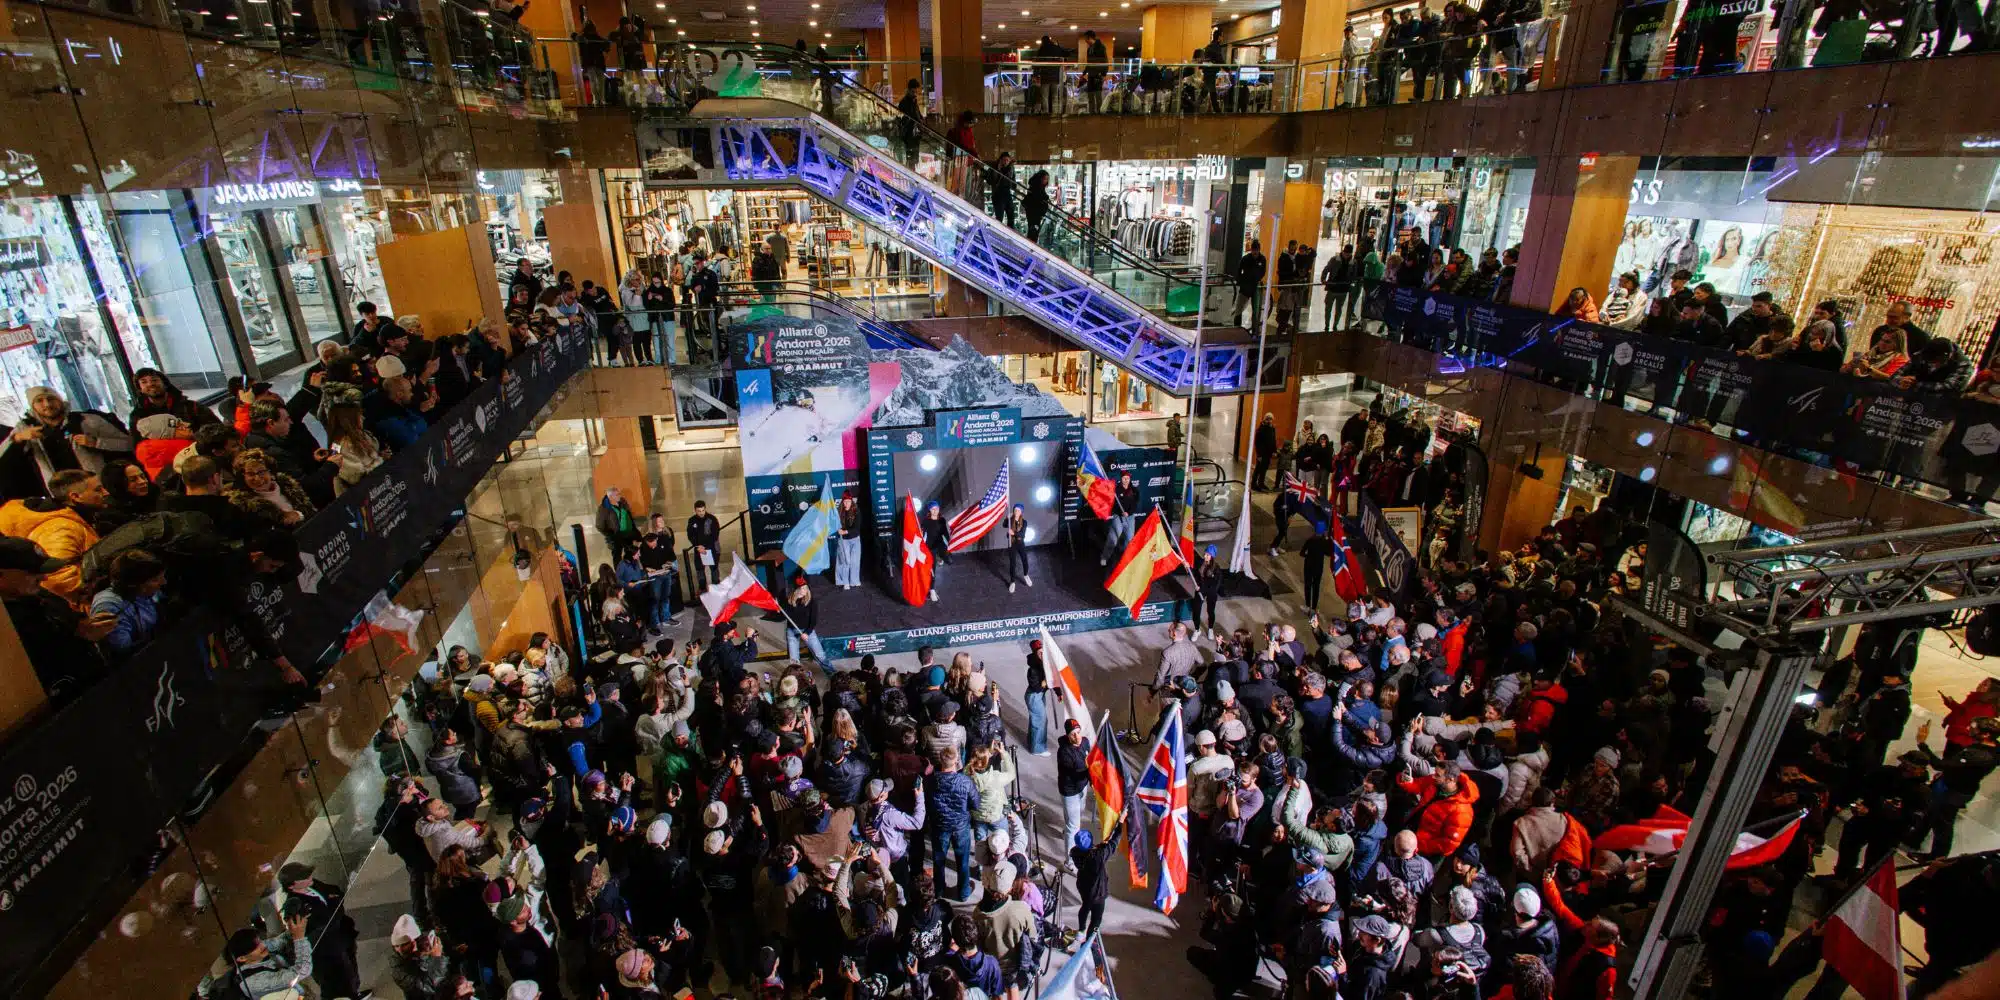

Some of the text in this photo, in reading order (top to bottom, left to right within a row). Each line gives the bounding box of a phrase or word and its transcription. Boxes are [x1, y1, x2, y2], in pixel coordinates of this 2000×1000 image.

[1184, 166, 1228, 180] RAW
[778, 328, 813, 337] Allianz
[775, 336, 851, 349] Andorra 2026
[1636, 351, 1666, 362] ORDINO
[796, 362, 842, 371] MAMMUT
[1867, 405, 1944, 429] Andorra 2026
[318, 530, 346, 559] ORDINO
[907, 628, 945, 638] ALLIANZ
[962, 621, 1003, 632] FREERIDE
[1004, 617, 1036, 627] WORLD
[1038, 610, 1110, 624] CHAMPIONSHIPS
[950, 633, 994, 644] ANDORRA
[995, 629, 1015, 638] 2026
[1017, 628, 1029, 636] BY
[36, 764, 78, 811] 2026
[13, 818, 84, 892] MAMMUT
